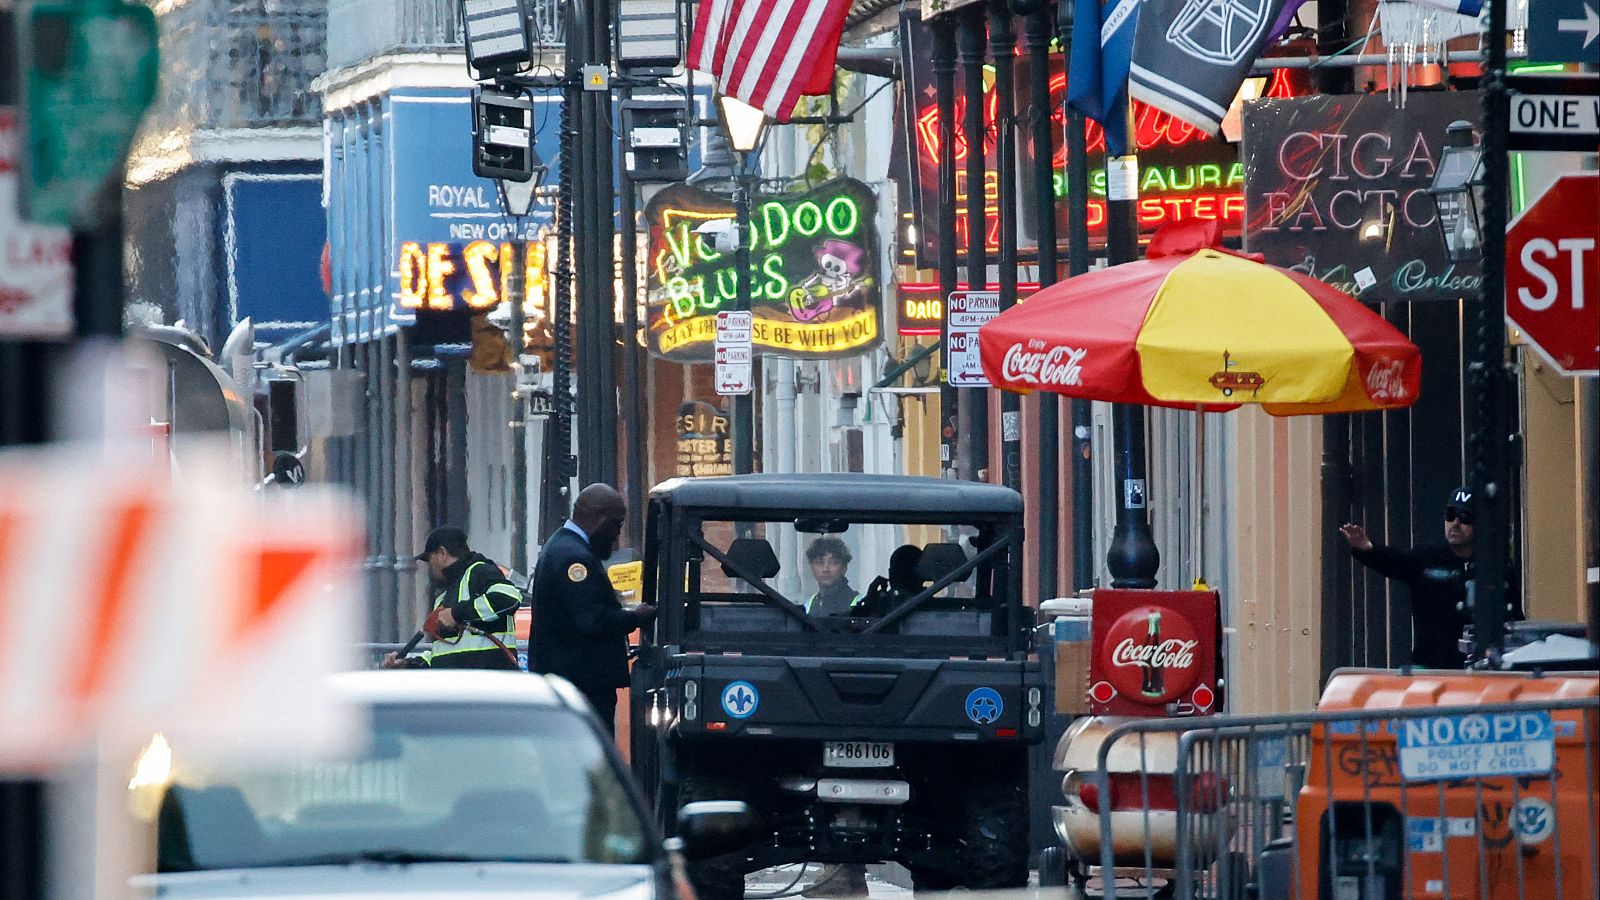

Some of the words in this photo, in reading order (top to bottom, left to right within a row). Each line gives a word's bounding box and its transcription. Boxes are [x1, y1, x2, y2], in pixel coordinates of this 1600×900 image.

[1517, 99, 1580, 129] ONE
[1279, 131, 1482, 181] CIGA
[428, 184, 490, 209] ROYAL
[449, 222, 485, 240] NEW
[950, 297, 967, 310] NO
[968, 296, 999, 309] PARKIN
[774, 327, 792, 344] BE
[798, 328, 835, 347] WITH
[842, 314, 873, 342] YOU
[950, 336, 967, 349] NO
[1002, 342, 1087, 386] Coca-Cola
[1112, 637, 1199, 669] Coca-Cola
[1427, 746, 1482, 760] POLICE
[1494, 743, 1526, 756] LINE
[1417, 761, 1439, 774] DO
[1450, 759, 1480, 772] NOT
[1488, 756, 1538, 770] CROSS
